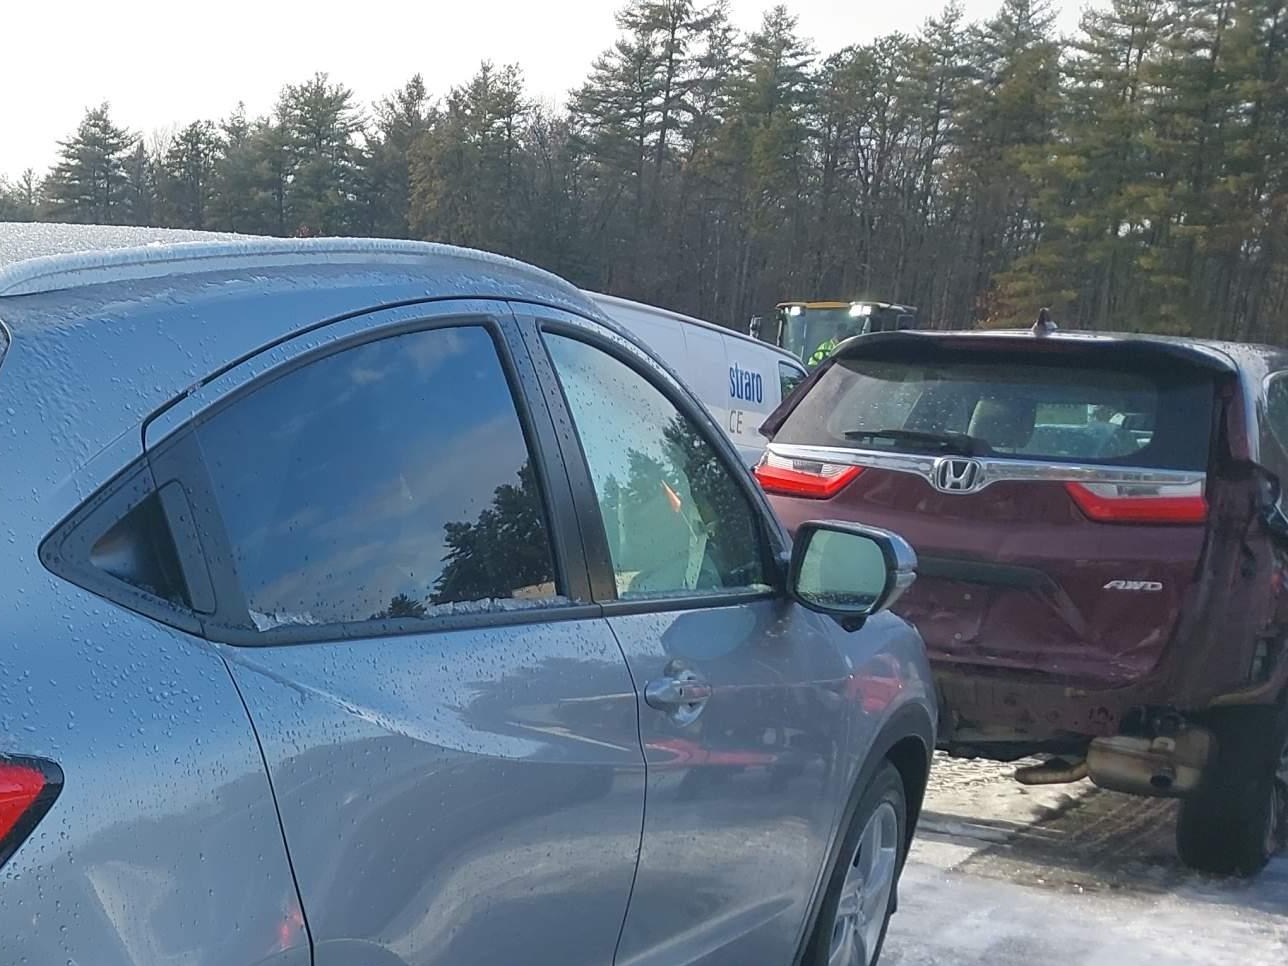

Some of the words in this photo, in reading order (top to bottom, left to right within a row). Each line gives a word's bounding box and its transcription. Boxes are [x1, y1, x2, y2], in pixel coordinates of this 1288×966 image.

[729, 361, 763, 404] straro
[729, 410, 743, 434] CE
[1103, 579, 1163, 591] AWD
